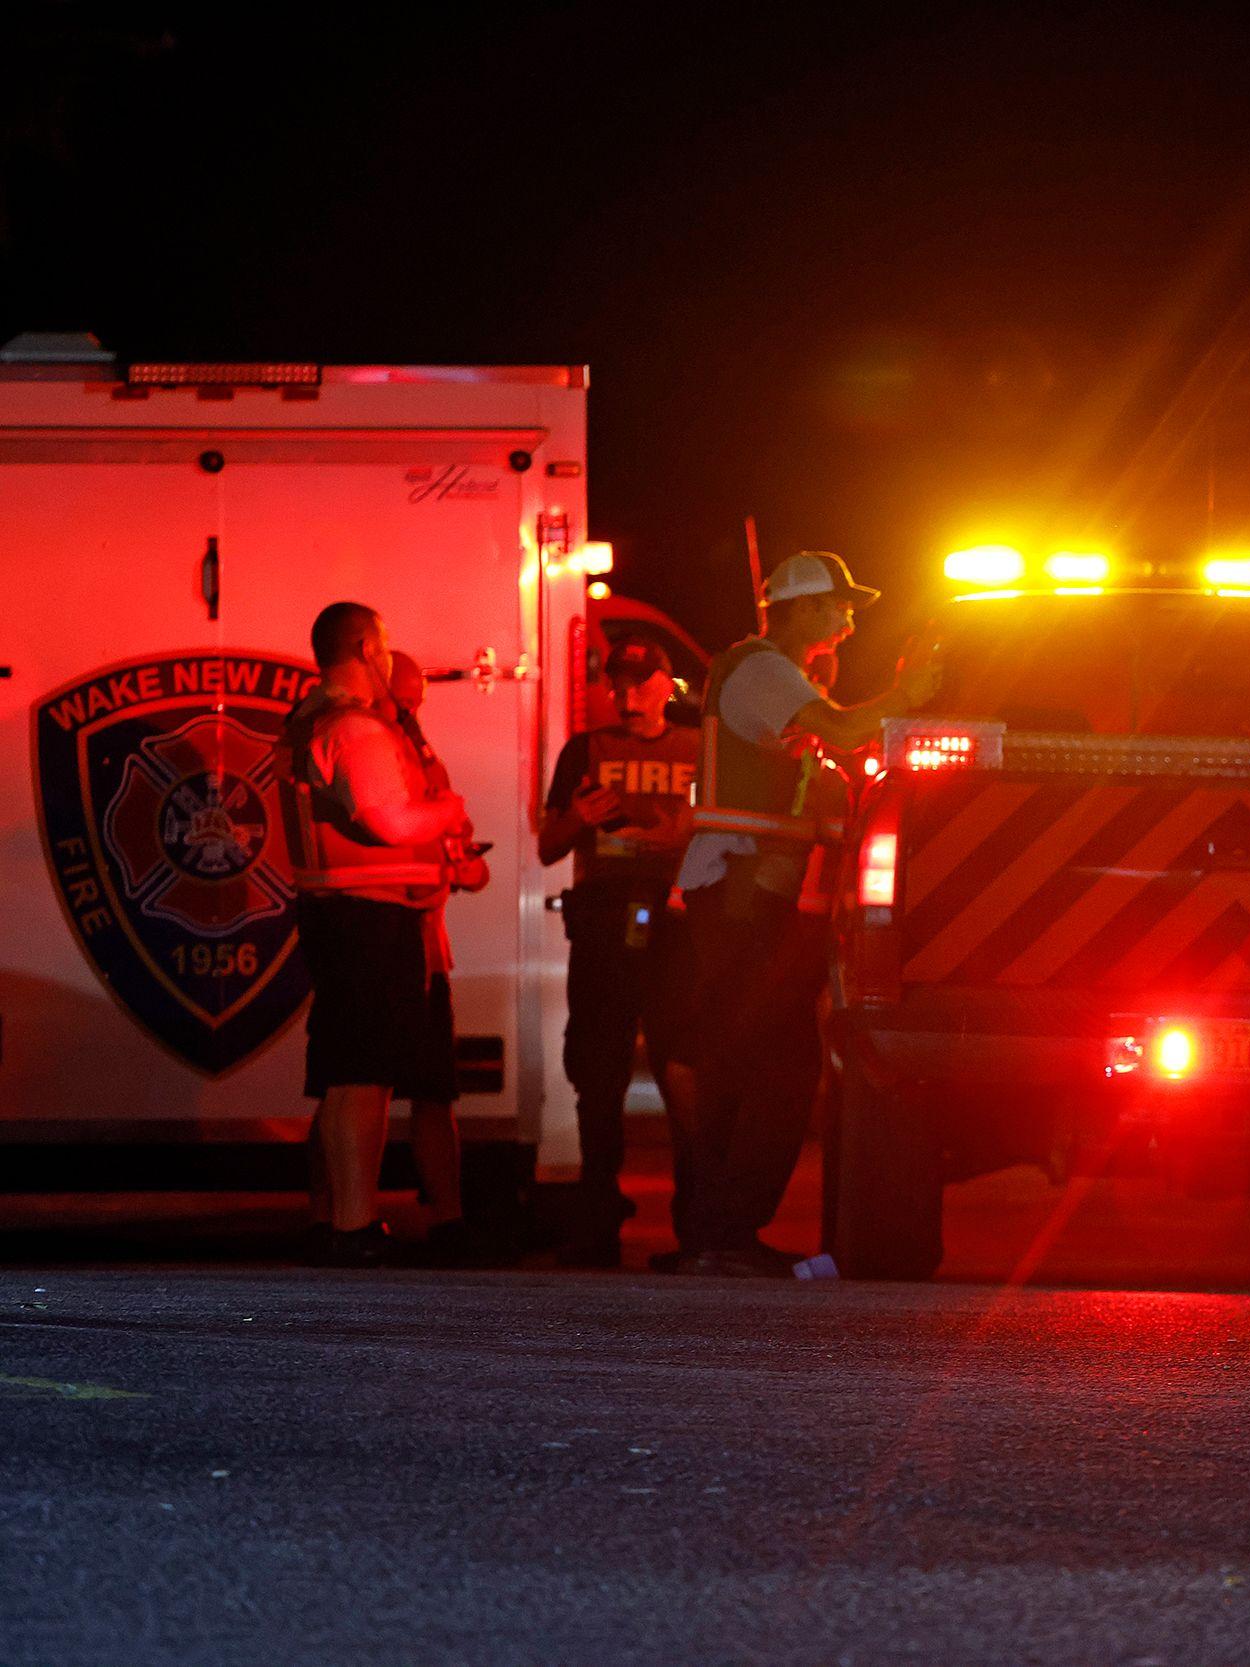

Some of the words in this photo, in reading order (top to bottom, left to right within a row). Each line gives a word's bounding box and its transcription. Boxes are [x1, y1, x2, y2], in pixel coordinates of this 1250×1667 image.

[49, 667, 164, 731] WAKE
[173, 660, 262, 693] NEW
[600, 761, 697, 794] FIRE
[56, 836, 113, 935] FIRE
[170, 943, 258, 977] 1956
